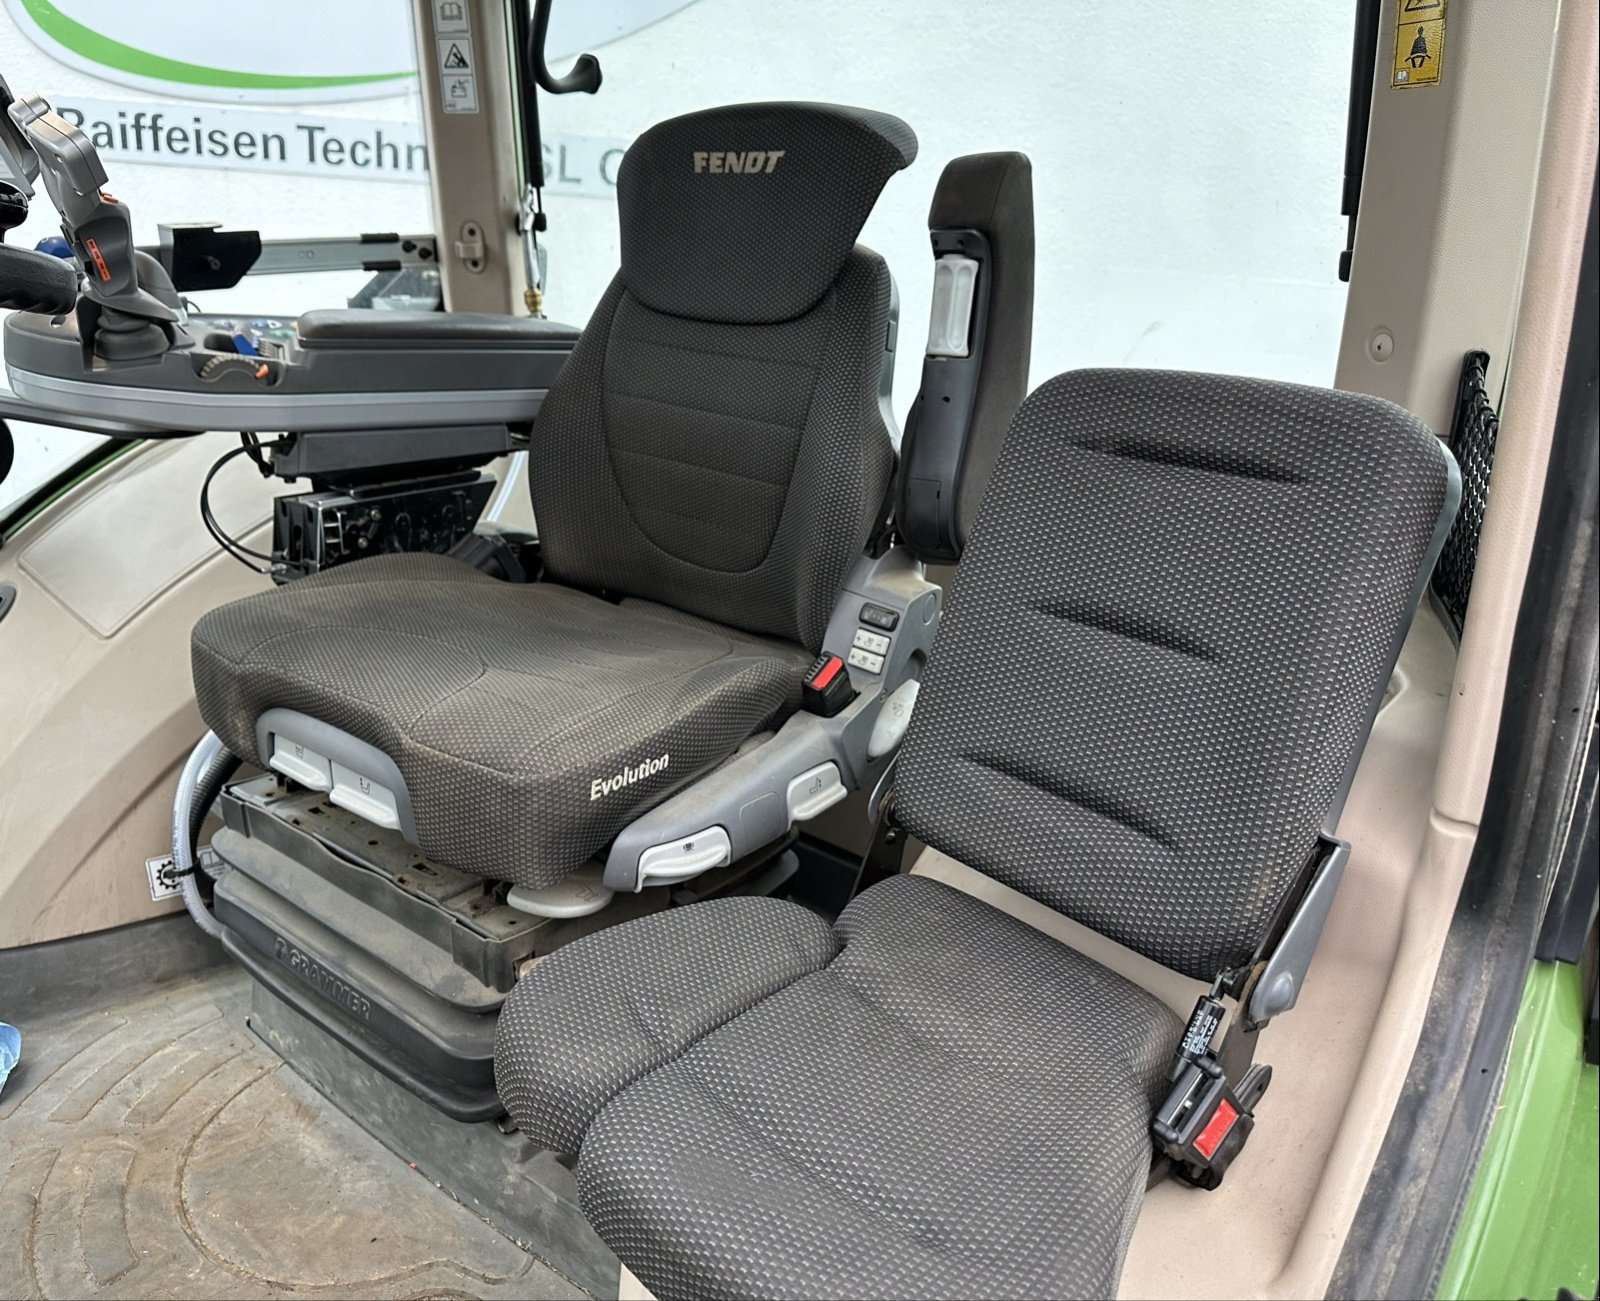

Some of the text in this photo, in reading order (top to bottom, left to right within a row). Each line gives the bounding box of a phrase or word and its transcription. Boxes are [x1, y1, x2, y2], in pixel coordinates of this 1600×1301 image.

[693, 150, 785, 173] FENDT
[590, 753, 669, 800] Evolution
[290, 948, 371, 1021] GRAMMER
